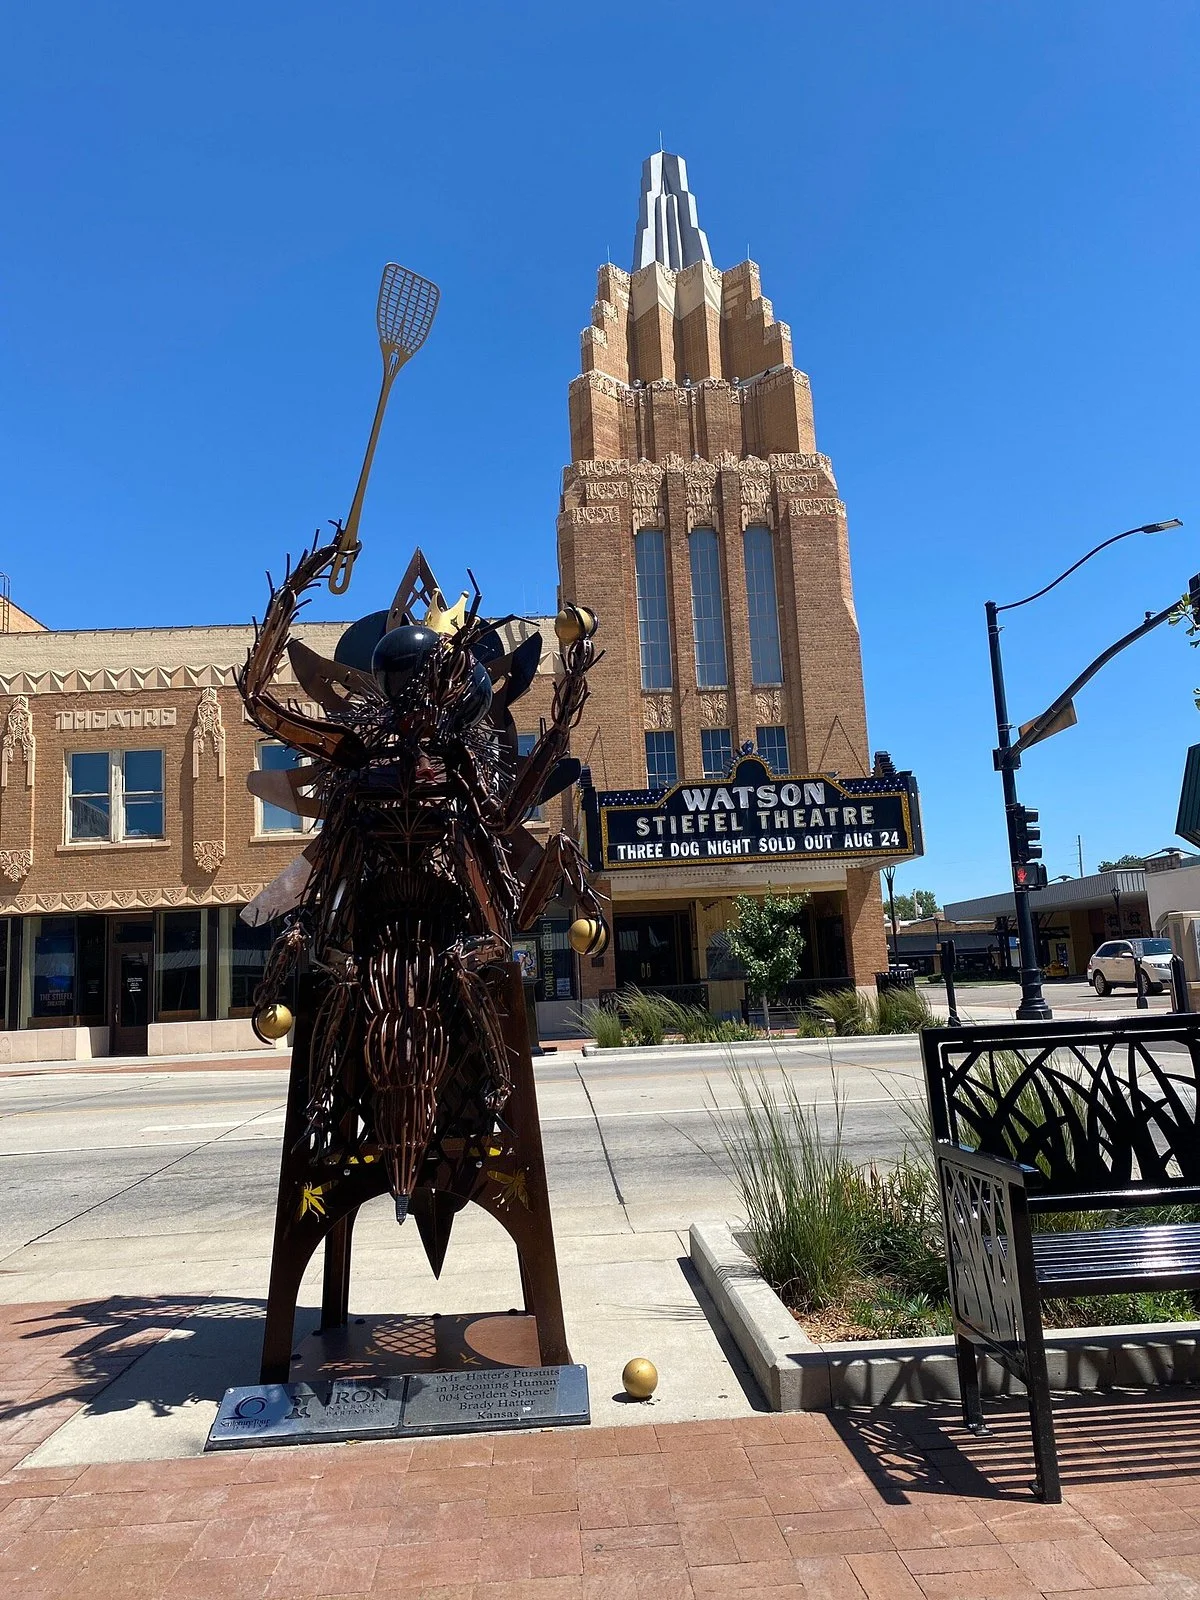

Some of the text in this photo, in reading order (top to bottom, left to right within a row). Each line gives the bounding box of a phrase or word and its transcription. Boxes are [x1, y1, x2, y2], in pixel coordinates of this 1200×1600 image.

[55, 707, 177, 731] THEATRE
[681, 782, 826, 812] WATSON
[636, 805, 876, 837] STIEFEL THEATRE
[617, 843, 664, 860] THREE
[671, 841, 700, 857] DOG
[758, 836, 797, 854] SOLD
[804, 833, 833, 850] OUT
[844, 831, 873, 848] AUG
[880, 830, 900, 847] 24
[466, 1371, 510, 1382] Hatter's
[513, 1369, 560, 1378] Pursuits
[435, 1385, 447, 1393] in
[451, 1382, 509, 1392] Becoming
[438, 1393, 460, 1402] 004
[463, 1390, 507, 1400] Golden
[459, 1399, 536, 1411] Brady Hatter
[477, 1411, 519, 1420] Kansas
